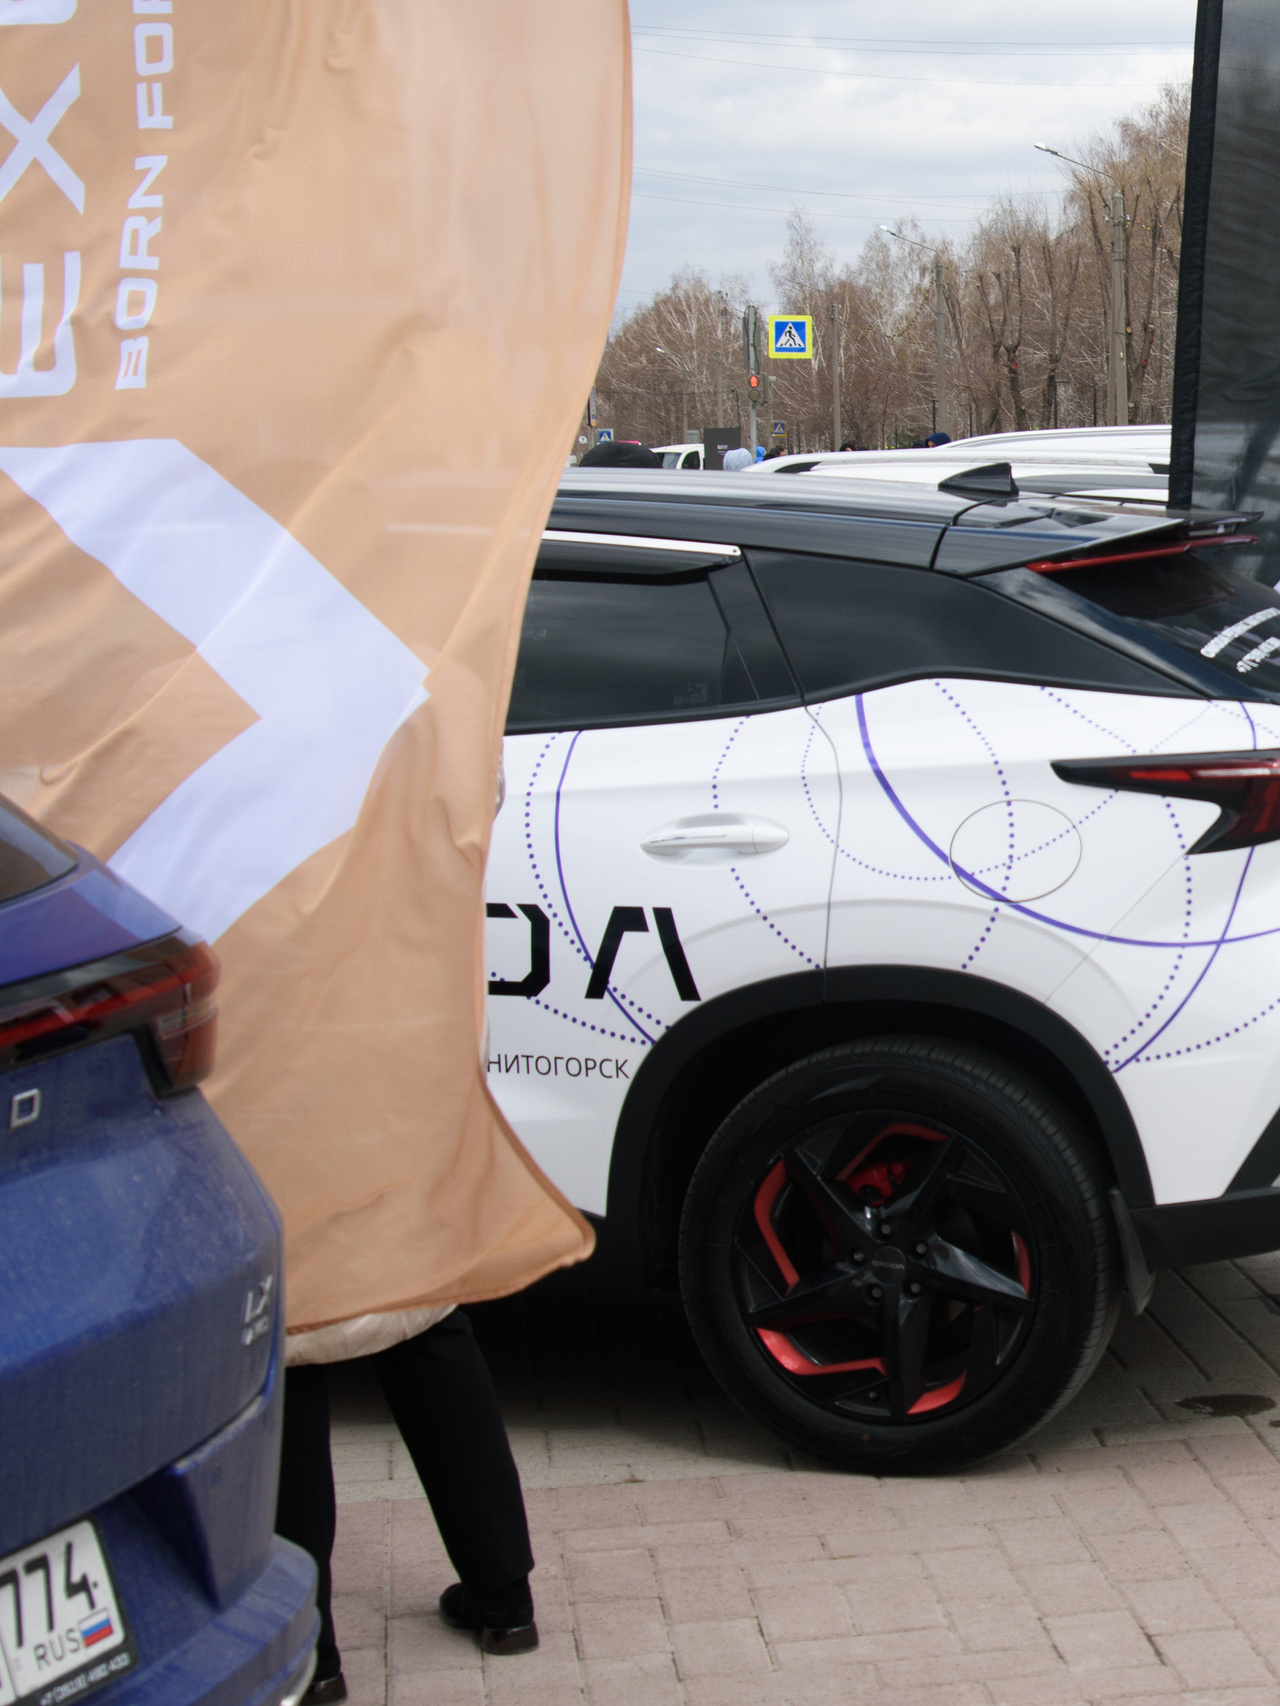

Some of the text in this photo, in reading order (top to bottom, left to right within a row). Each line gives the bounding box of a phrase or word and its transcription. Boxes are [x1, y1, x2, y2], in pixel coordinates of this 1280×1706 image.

[115, 0, 174, 391] BORN FO
[33, 1628, 81, 1670] RUS
